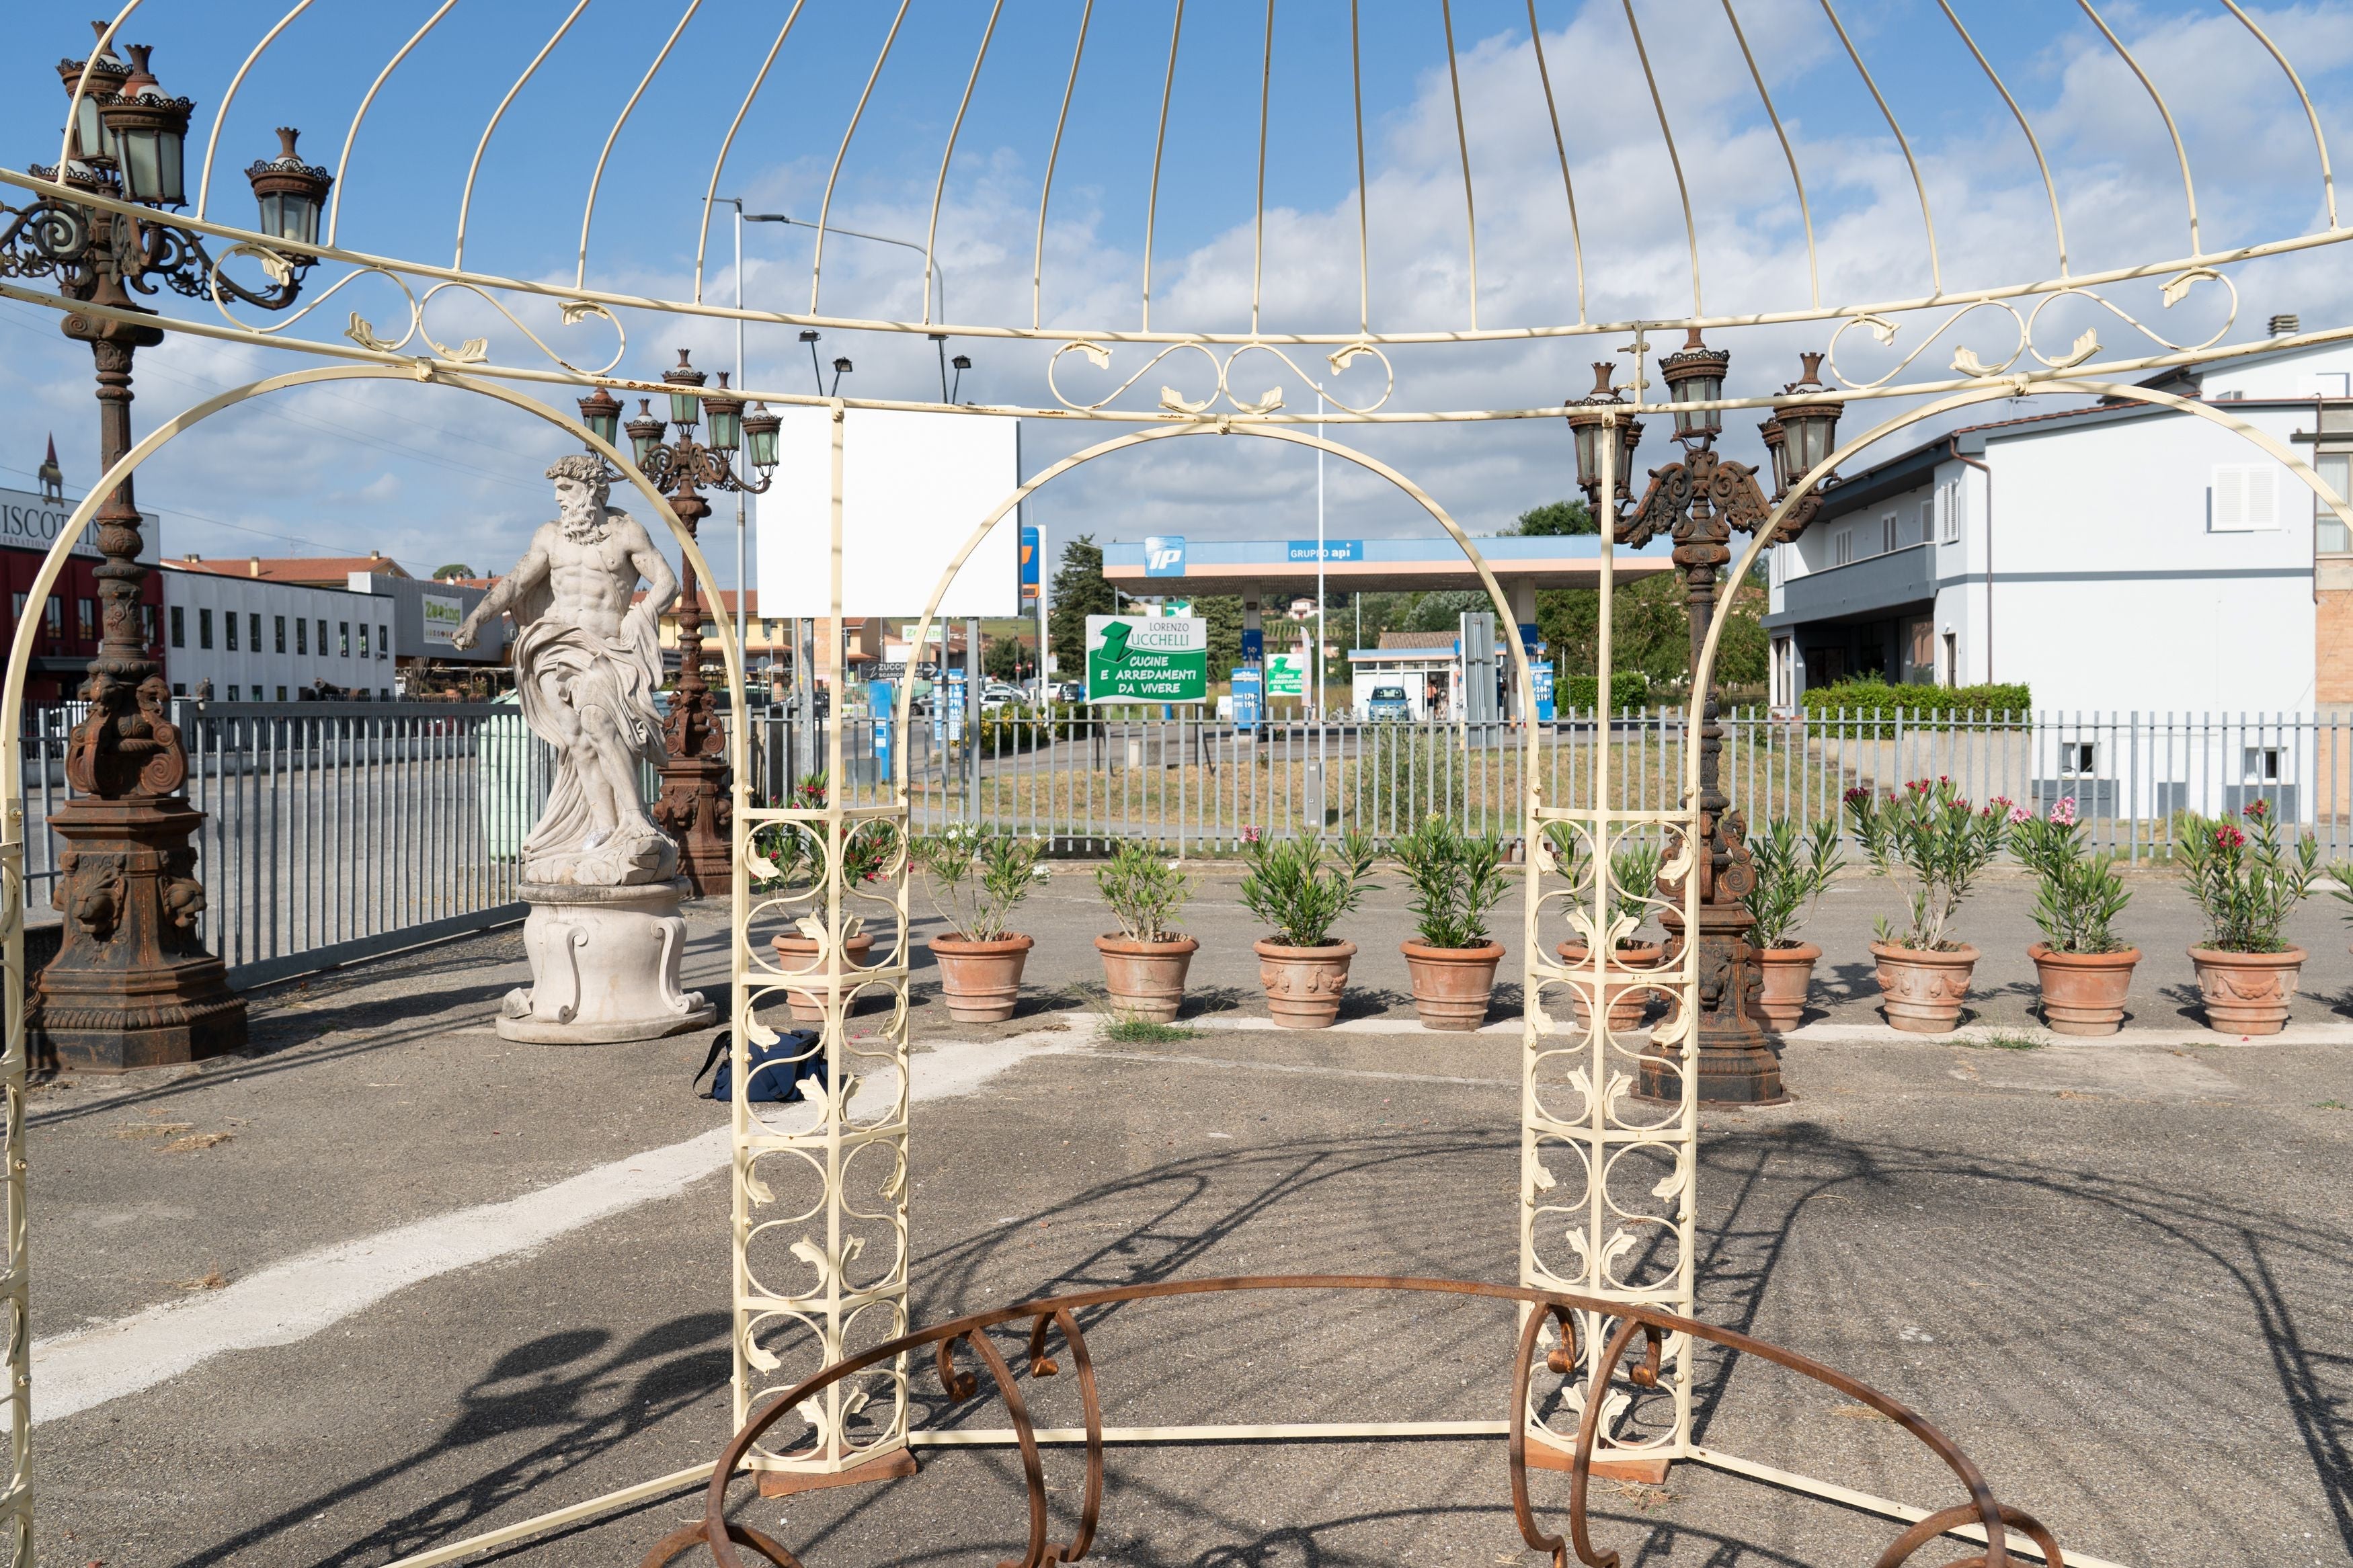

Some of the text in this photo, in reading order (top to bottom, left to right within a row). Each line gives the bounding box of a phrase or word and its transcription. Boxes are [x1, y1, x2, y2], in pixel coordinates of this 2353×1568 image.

[1331, 542, 1351, 559] api
[426, 601, 461, 626] Zooing
[1150, 622, 1189, 632] LORENZO
[1129, 656, 1168, 667] CUCINE
[1100, 669, 1197, 680] E ARREDAMENTI
[1118, 683, 1181, 694] DA VIVERE
